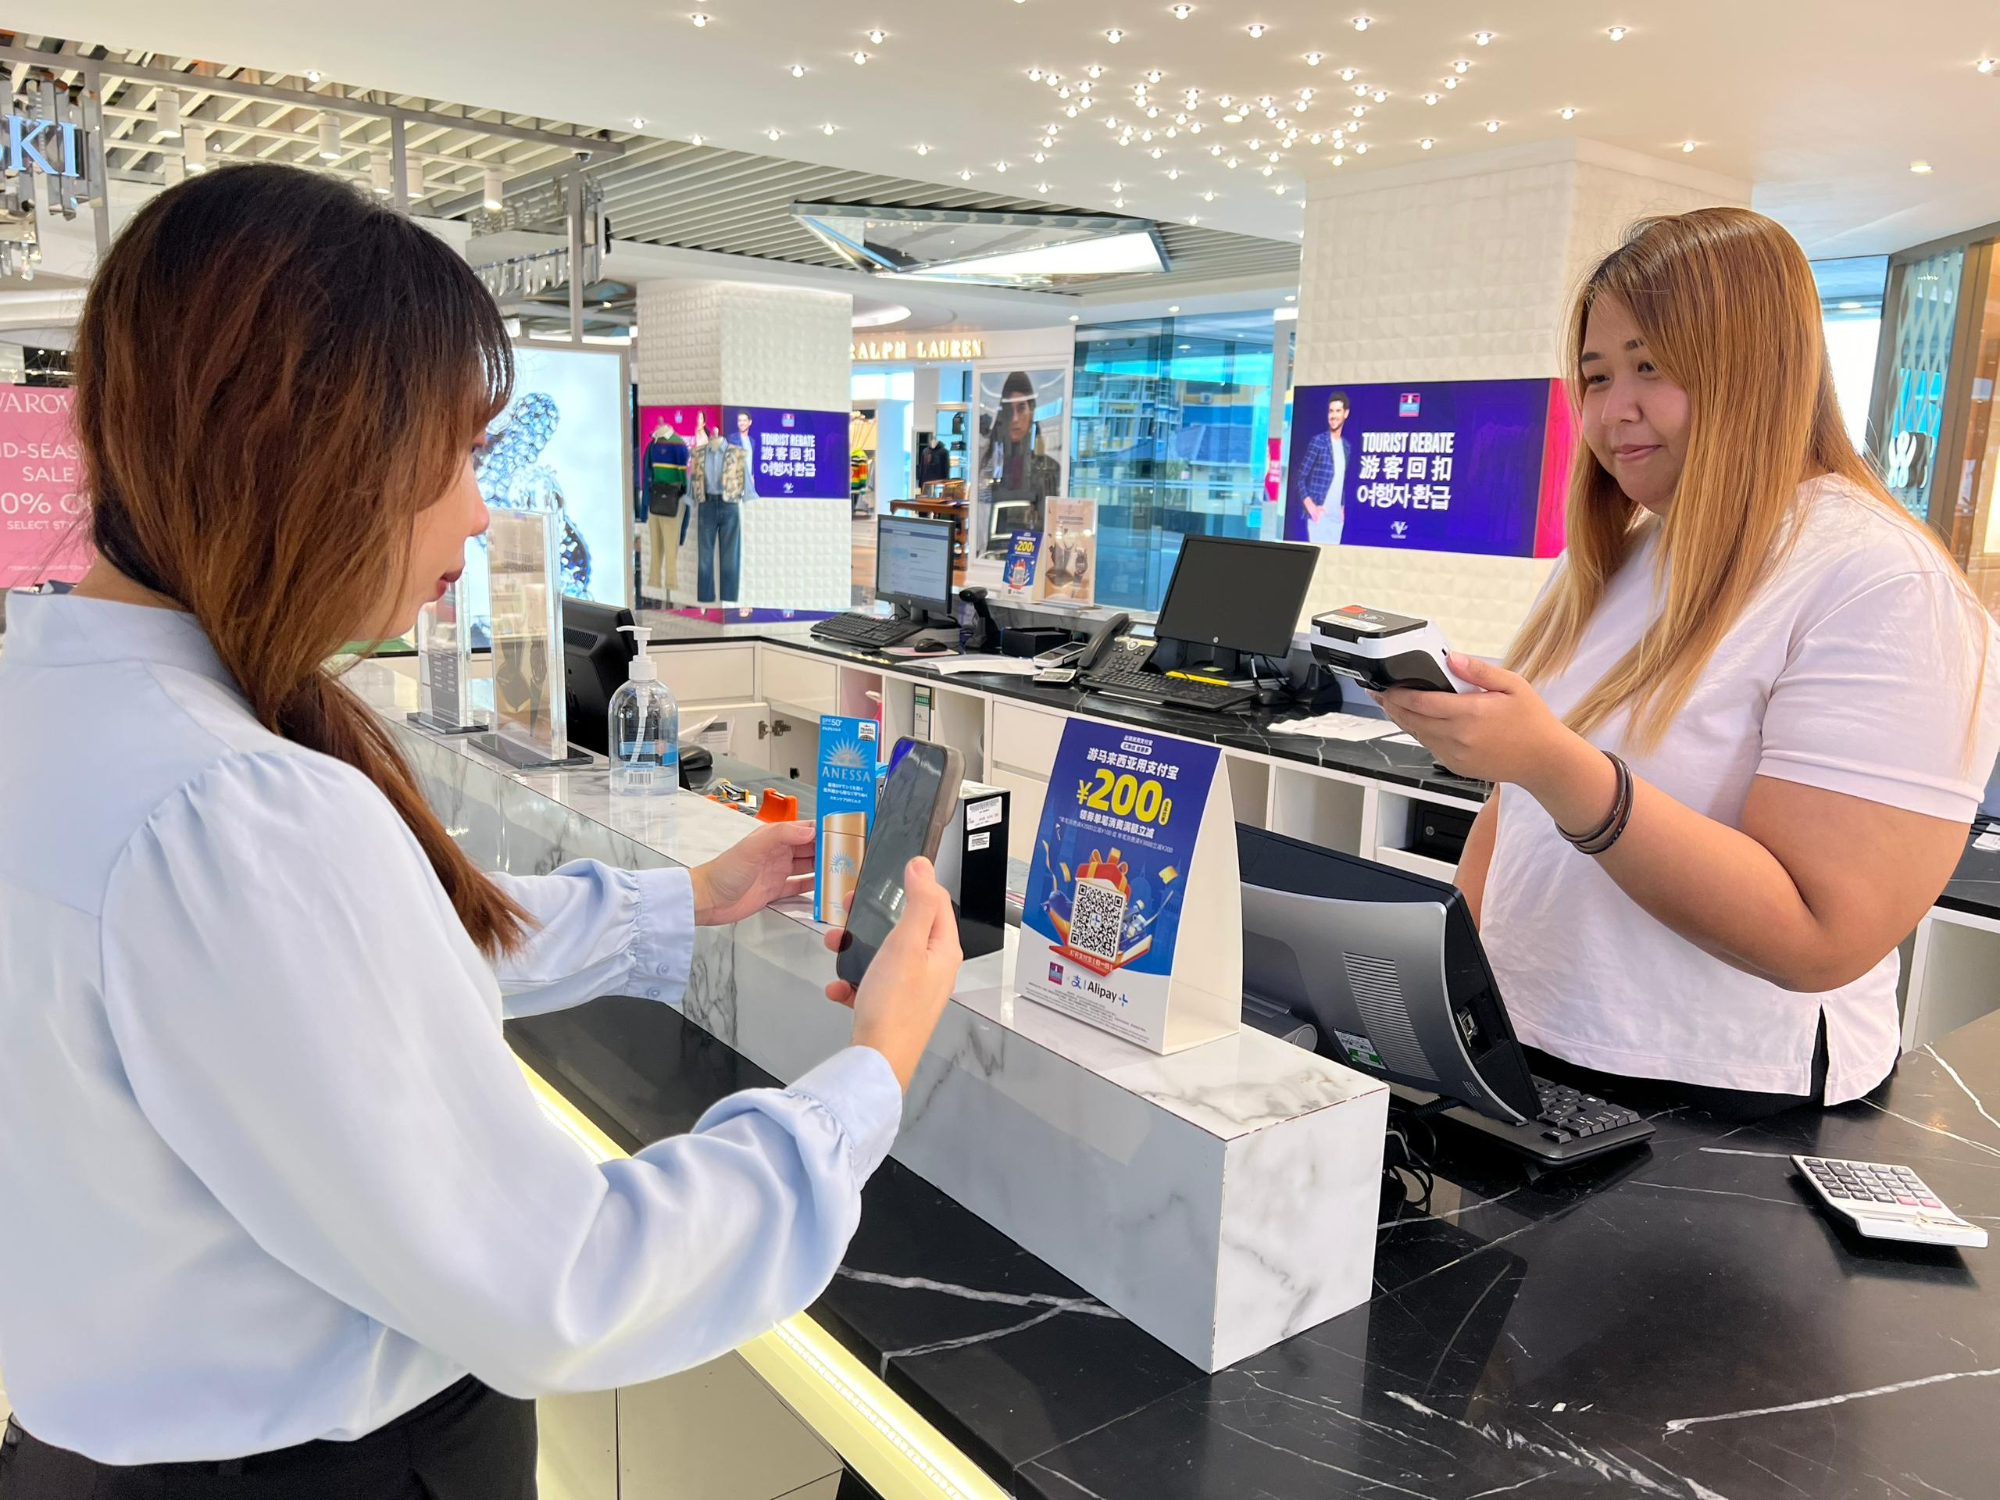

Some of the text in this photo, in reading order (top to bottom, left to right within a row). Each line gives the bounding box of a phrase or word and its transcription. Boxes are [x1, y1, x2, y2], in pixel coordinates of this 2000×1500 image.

[0, 114, 80, 177] KI
[917, 339, 983, 359] LAUREN
[761, 432, 790, 446] TOURIST
[1362, 432, 1455, 453] TOURIST REBATE
[22, 466, 75, 482] SALE
[1, 492, 51, 514] 0%
[7, 520, 82, 531] SELECT STY
[1087, 747, 1179, 780] 游马来西亚用支付宝
[822, 766, 871, 783] ANESSA
[1077, 768, 1163, 823] ¥200
